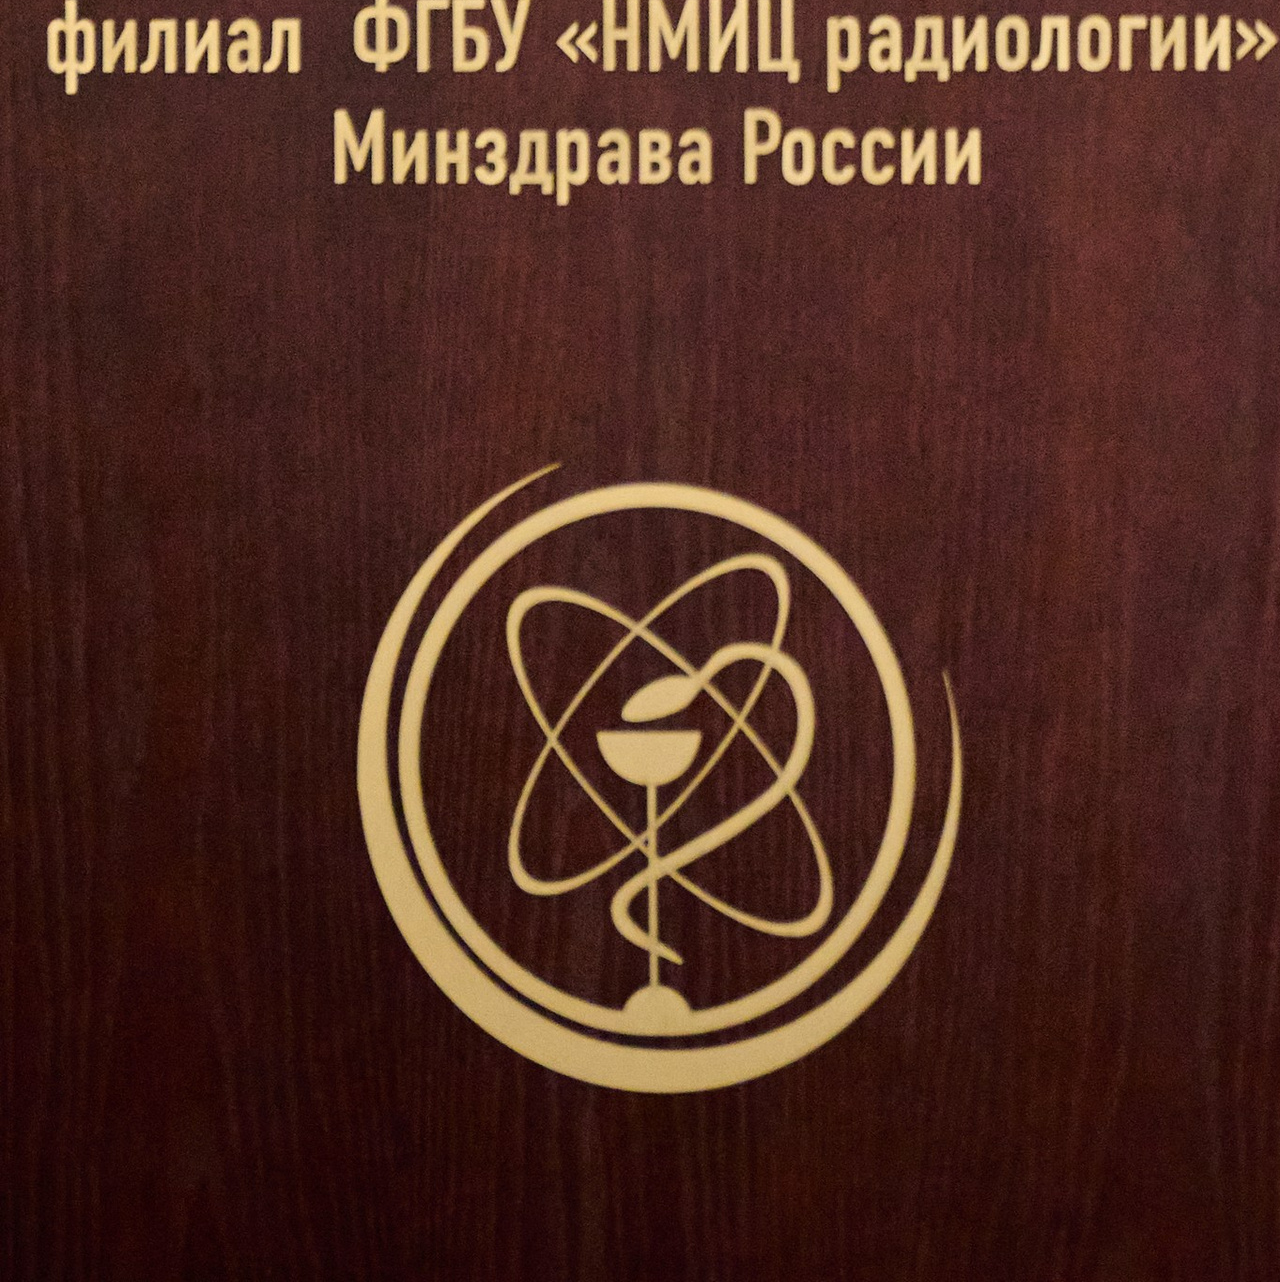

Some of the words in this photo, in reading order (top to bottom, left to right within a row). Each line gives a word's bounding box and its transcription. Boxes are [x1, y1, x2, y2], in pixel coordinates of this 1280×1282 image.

[825, 13, 1280, 94] радиологии»
[332, 107, 714, 208] Минздрава
[742, 105, 983, 187] России
